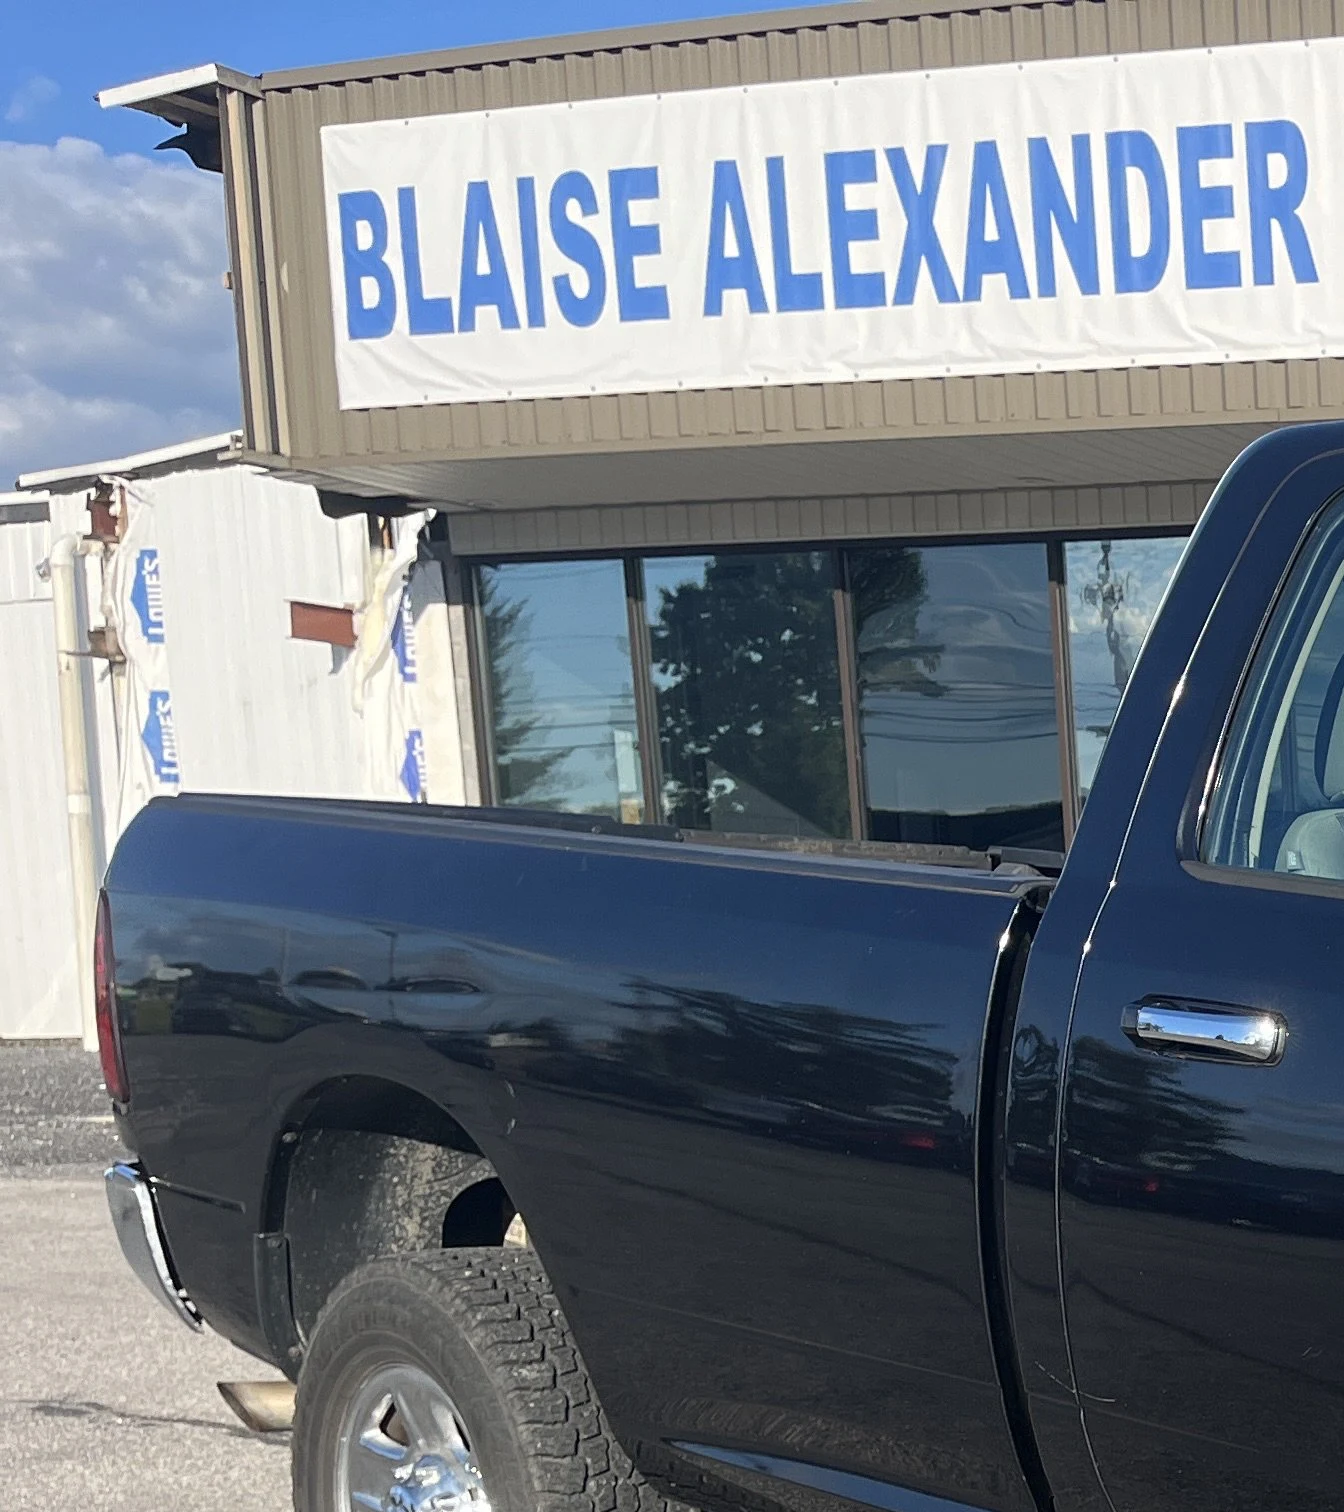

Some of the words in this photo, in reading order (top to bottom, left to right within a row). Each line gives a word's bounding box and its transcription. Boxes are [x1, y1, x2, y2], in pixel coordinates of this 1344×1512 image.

[337, 165, 671, 341] BLAISE
[703, 119, 1319, 318] ALEXANDER
[143, 555, 165, 638] LOWE'S
